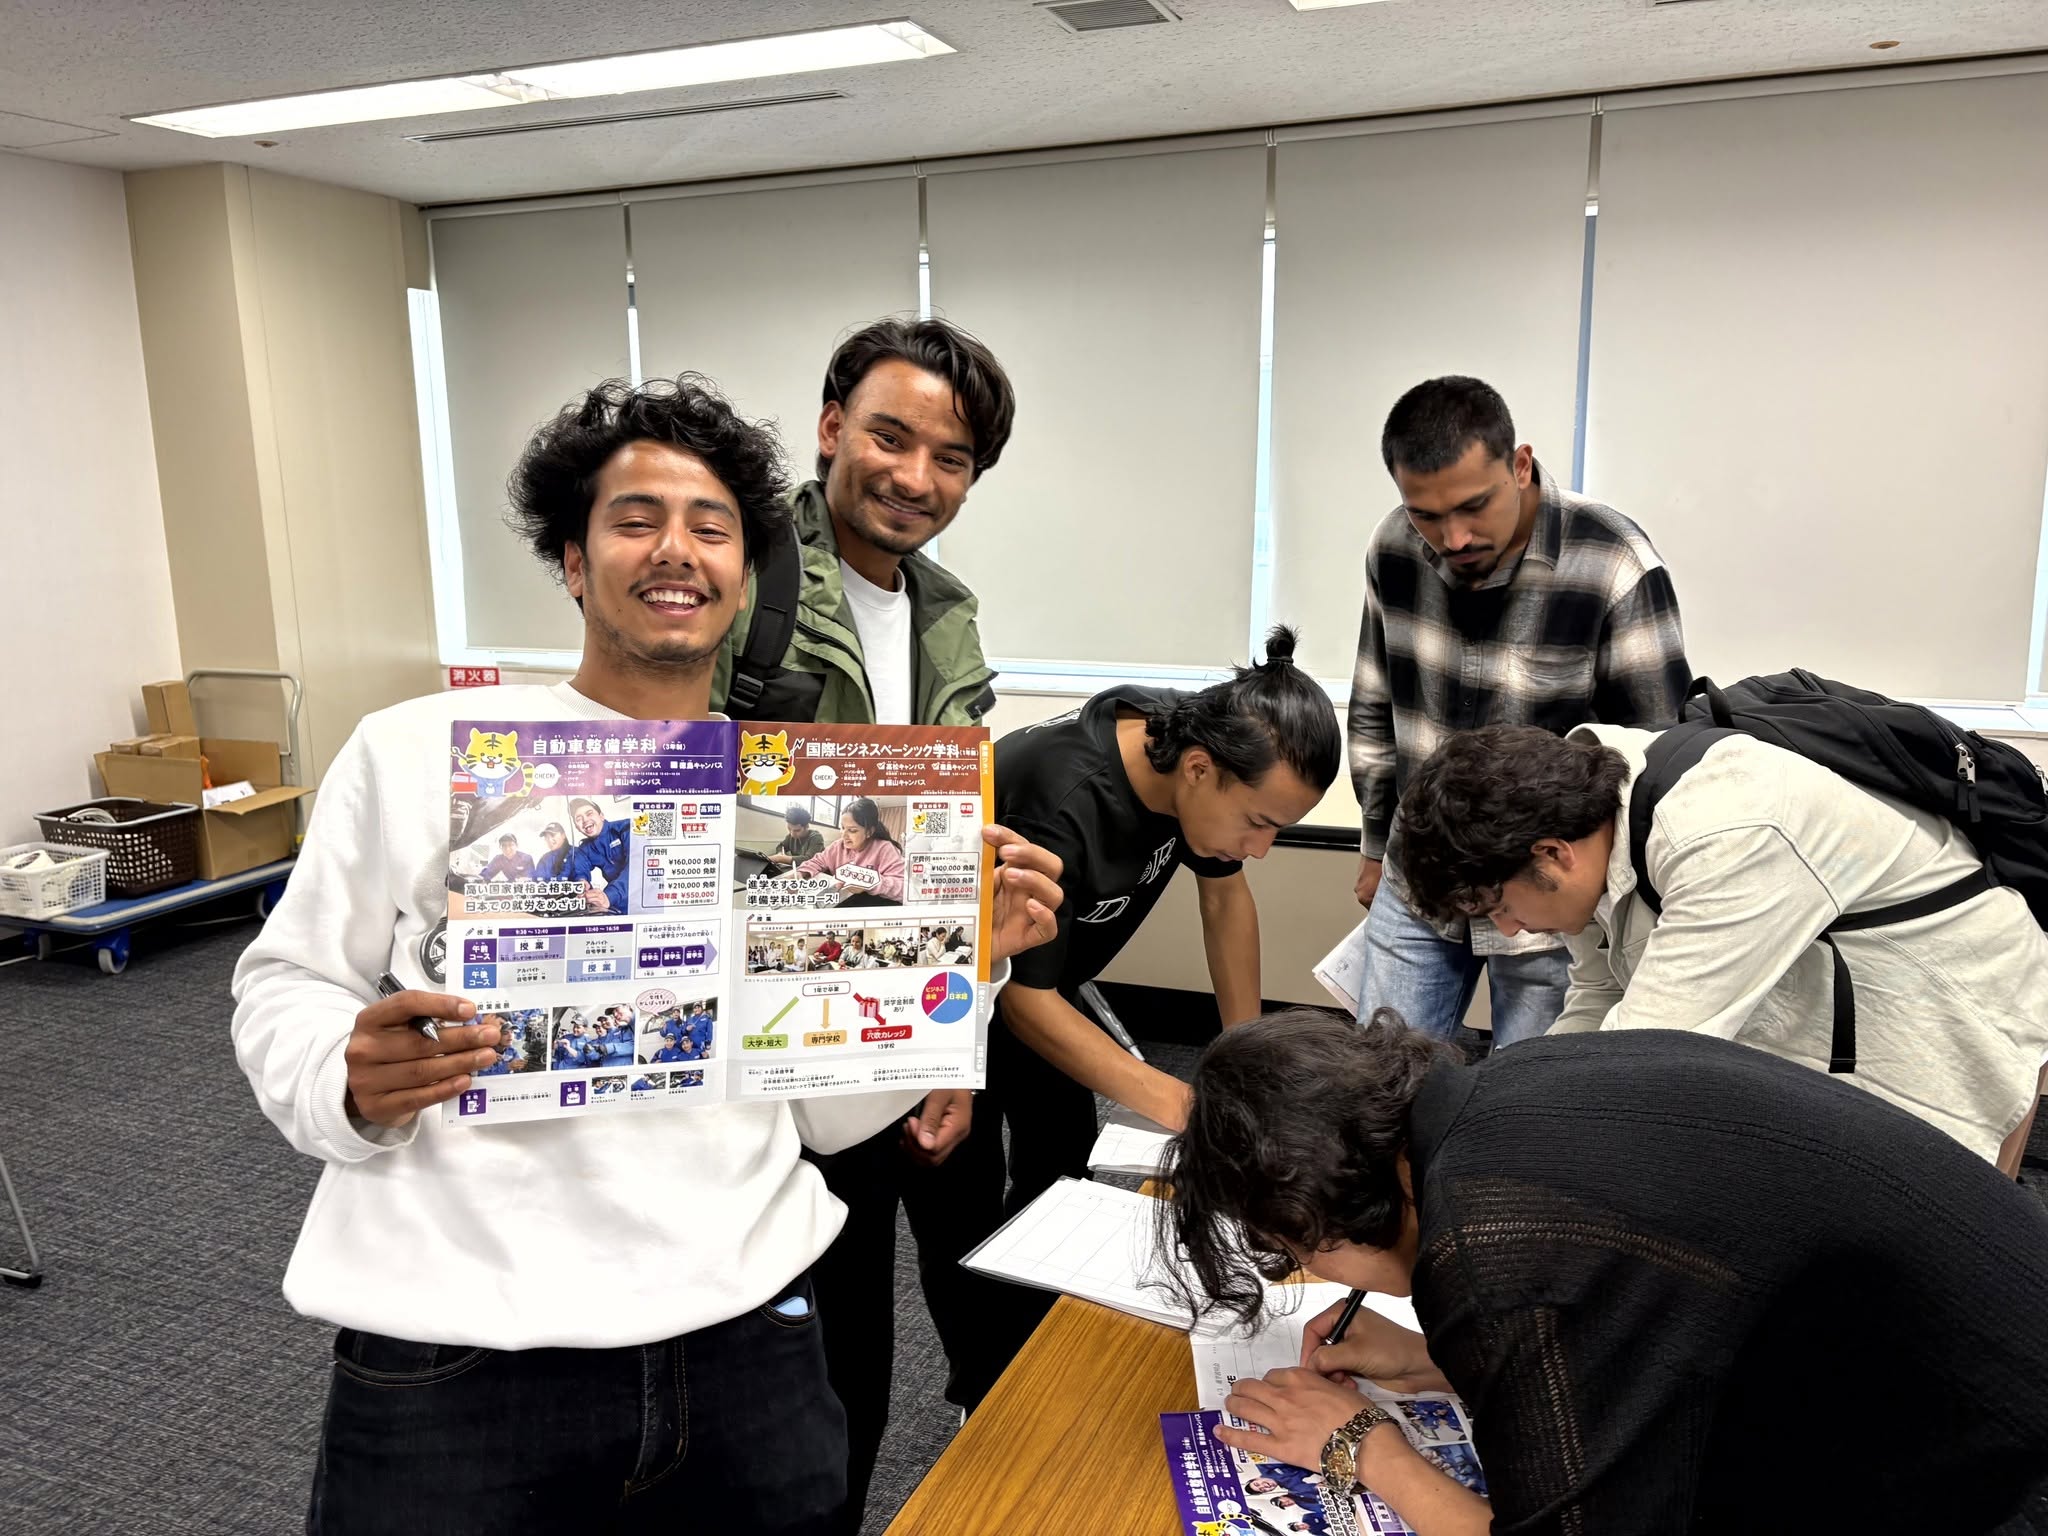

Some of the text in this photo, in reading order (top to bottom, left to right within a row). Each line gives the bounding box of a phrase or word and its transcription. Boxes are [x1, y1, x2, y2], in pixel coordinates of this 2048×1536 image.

[452, 669, 497, 682] 消火器
[533, 738, 657, 755] 自動車整備学科
[806, 742, 960, 758] 国際ビジネスベーシック学科
[668, 858, 701, 866] ¥160,000
[671, 868, 701, 876] ¥50,000
[465, 881, 585, 895] 高い国家資格合格率で
[748, 879, 828, 890] 進学をするための
[465, 898, 586, 912] 日本での就労をめざす!
[747, 894, 839, 905] 準備学科1年コース!
[519, 941, 544, 951] 授業
[811, 1034, 841, 1044] 専門学校
[866, 1030, 906, 1039] 穴吹カレッジ
[747, 1039, 782, 1047] 大学・短大
